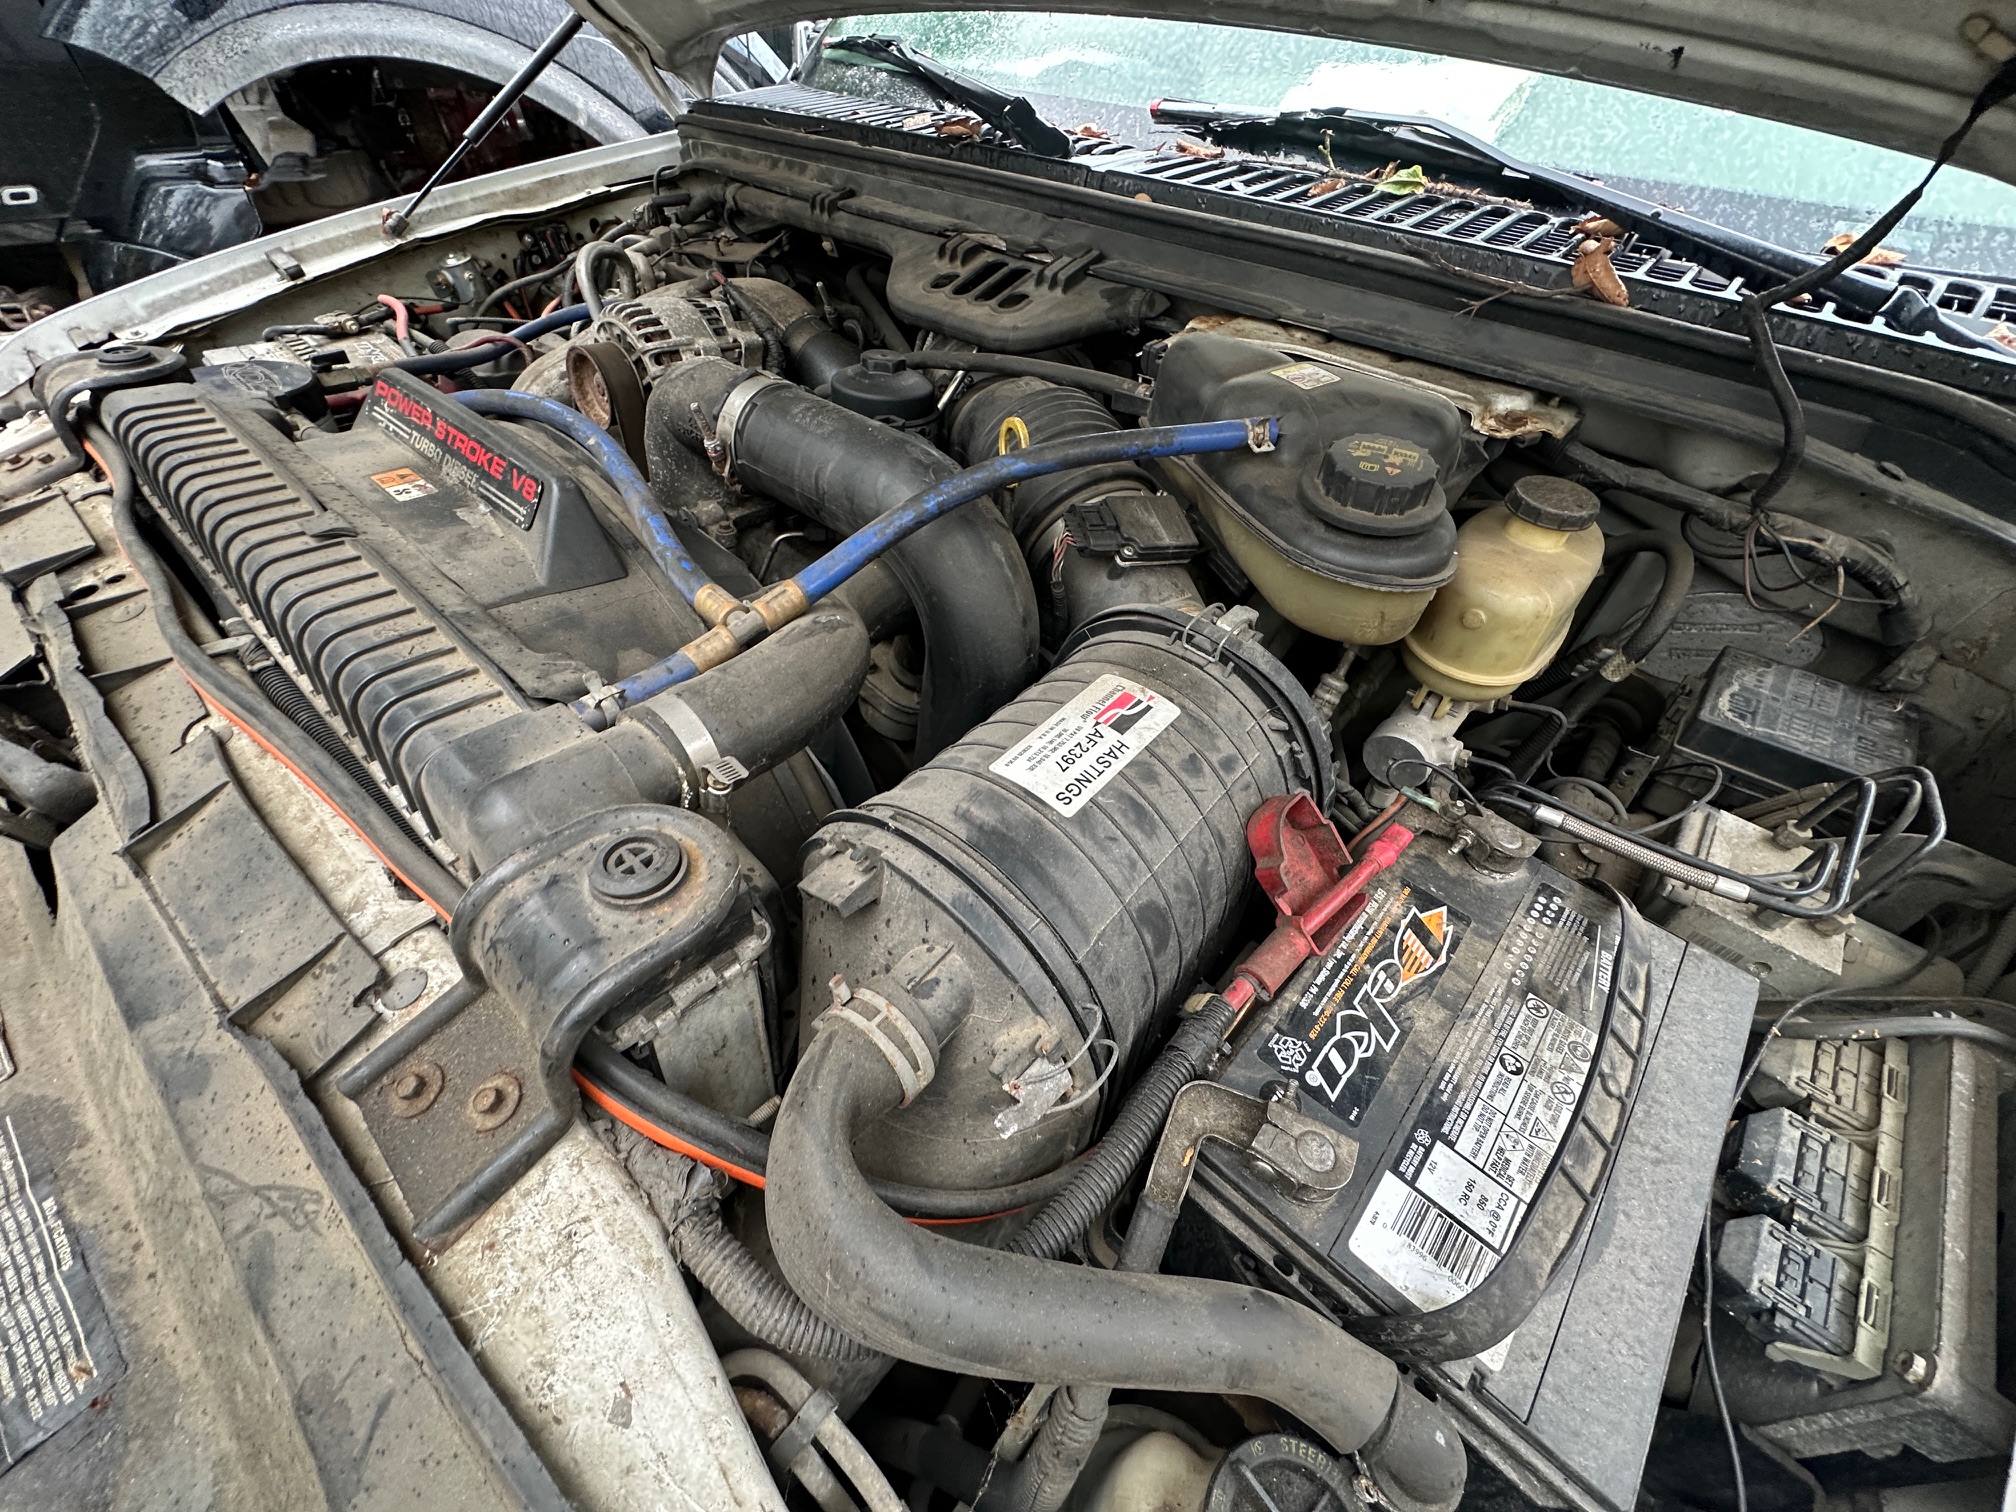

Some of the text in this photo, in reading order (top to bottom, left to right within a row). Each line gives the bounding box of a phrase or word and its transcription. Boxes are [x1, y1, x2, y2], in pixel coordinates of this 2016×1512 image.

[374, 380, 538, 502] POWER STROKE V8
[409, 430, 479, 490] TURBO DIESEL
[1095, 683, 1125, 706] Channel
[1054, 727, 1104, 772] AF2397
[1053, 739, 1130, 806] HASTINGS
[1339, 974, 1353, 990] TOLL
[1597, 951, 1613, 994] BATTERY
[1307, 983, 1319, 994] PA
[1331, 986, 1345, 1003] FREE
[1497, 1075, 1512, 1097] READ ALL
[1475, 1110, 1486, 1124] NOT
[1480, 1103, 1489, 1114] DO
[1517, 1109, 1533, 1134] BLINDNESS
[1468, 1108, 1497, 1160] DO NOT OPEN BATTERY.
[1409, 1141, 1418, 1152] BE
[1409, 1144, 1425, 1168] BATTERY
[1426, 1158, 1438, 1175] 12V
[1487, 1144, 1506, 1175] HELP FAST.
[1495, 1155, 1511, 1180] MEDICAL
[1516, 1142, 1536, 1177] WITH WATER.
[1457, 1176, 1477, 1207] 150 RC
[1503, 1173, 1515, 1187] GET
[1475, 1193, 1489, 1211] 850
[1494, 1191, 1509, 1212] CCA
[1488, 1208, 1500, 1221] @
[42, 1197, 75, 1271] MOFICATIONS
[1406, 1242, 1428, 1262] 83996
